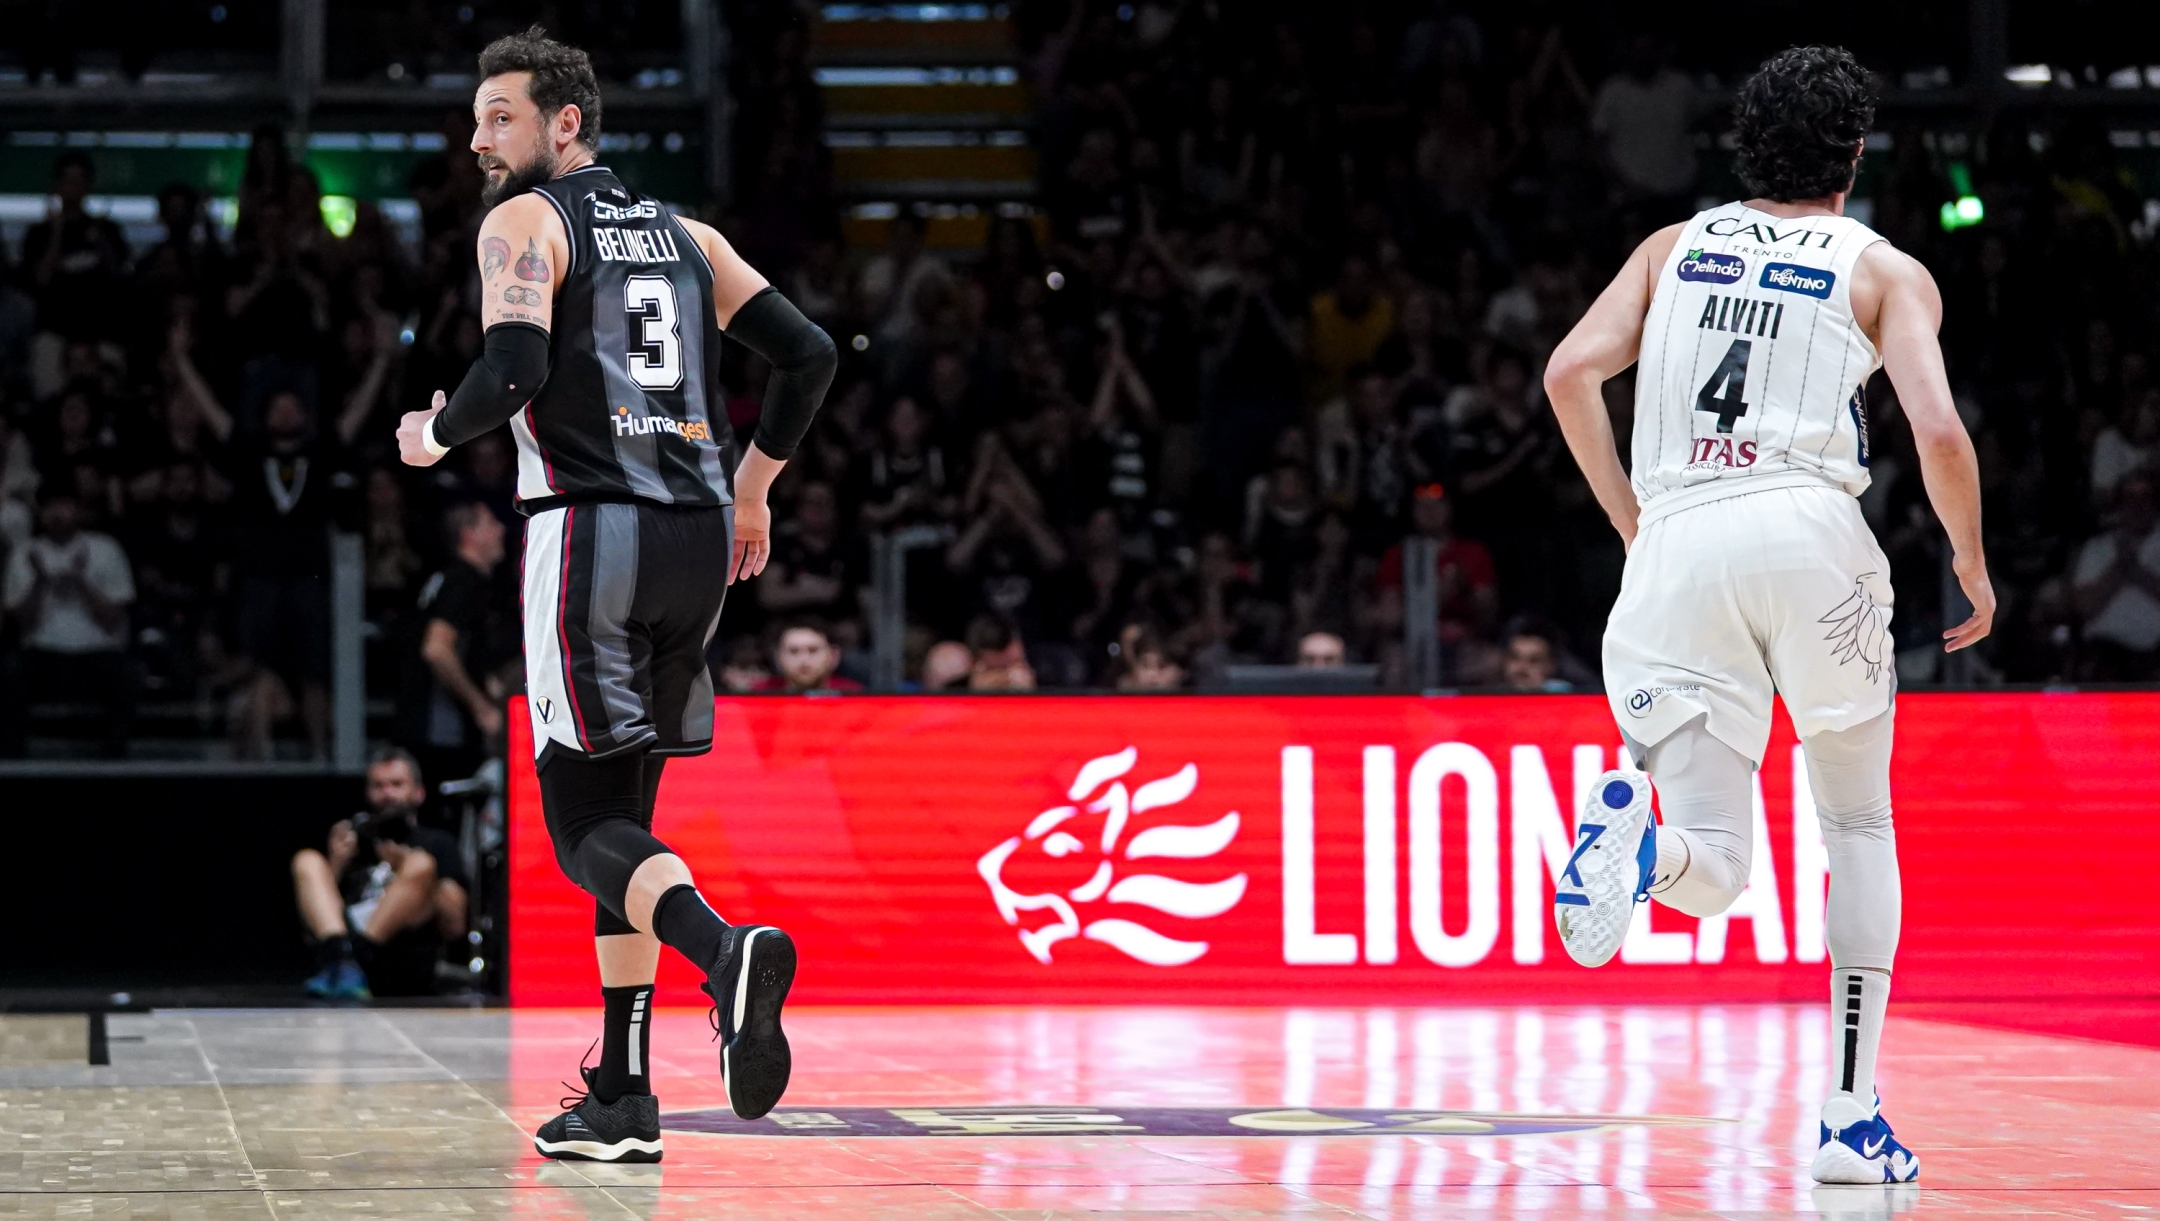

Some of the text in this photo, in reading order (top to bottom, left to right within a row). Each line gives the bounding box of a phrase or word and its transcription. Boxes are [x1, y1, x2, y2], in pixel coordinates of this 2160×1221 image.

[592, 227, 680, 263] BELINELLI
[1733, 245, 1793, 259] TRENTO
[1680, 258, 1742, 277] Melinda
[1769, 269, 1826, 291] TRENTINO
[624, 274, 684, 391] 3
[1698, 295, 1784, 339] ALVITI
[1695, 339, 1752, 434] 4
[1687, 438, 1757, 468] ITAS
